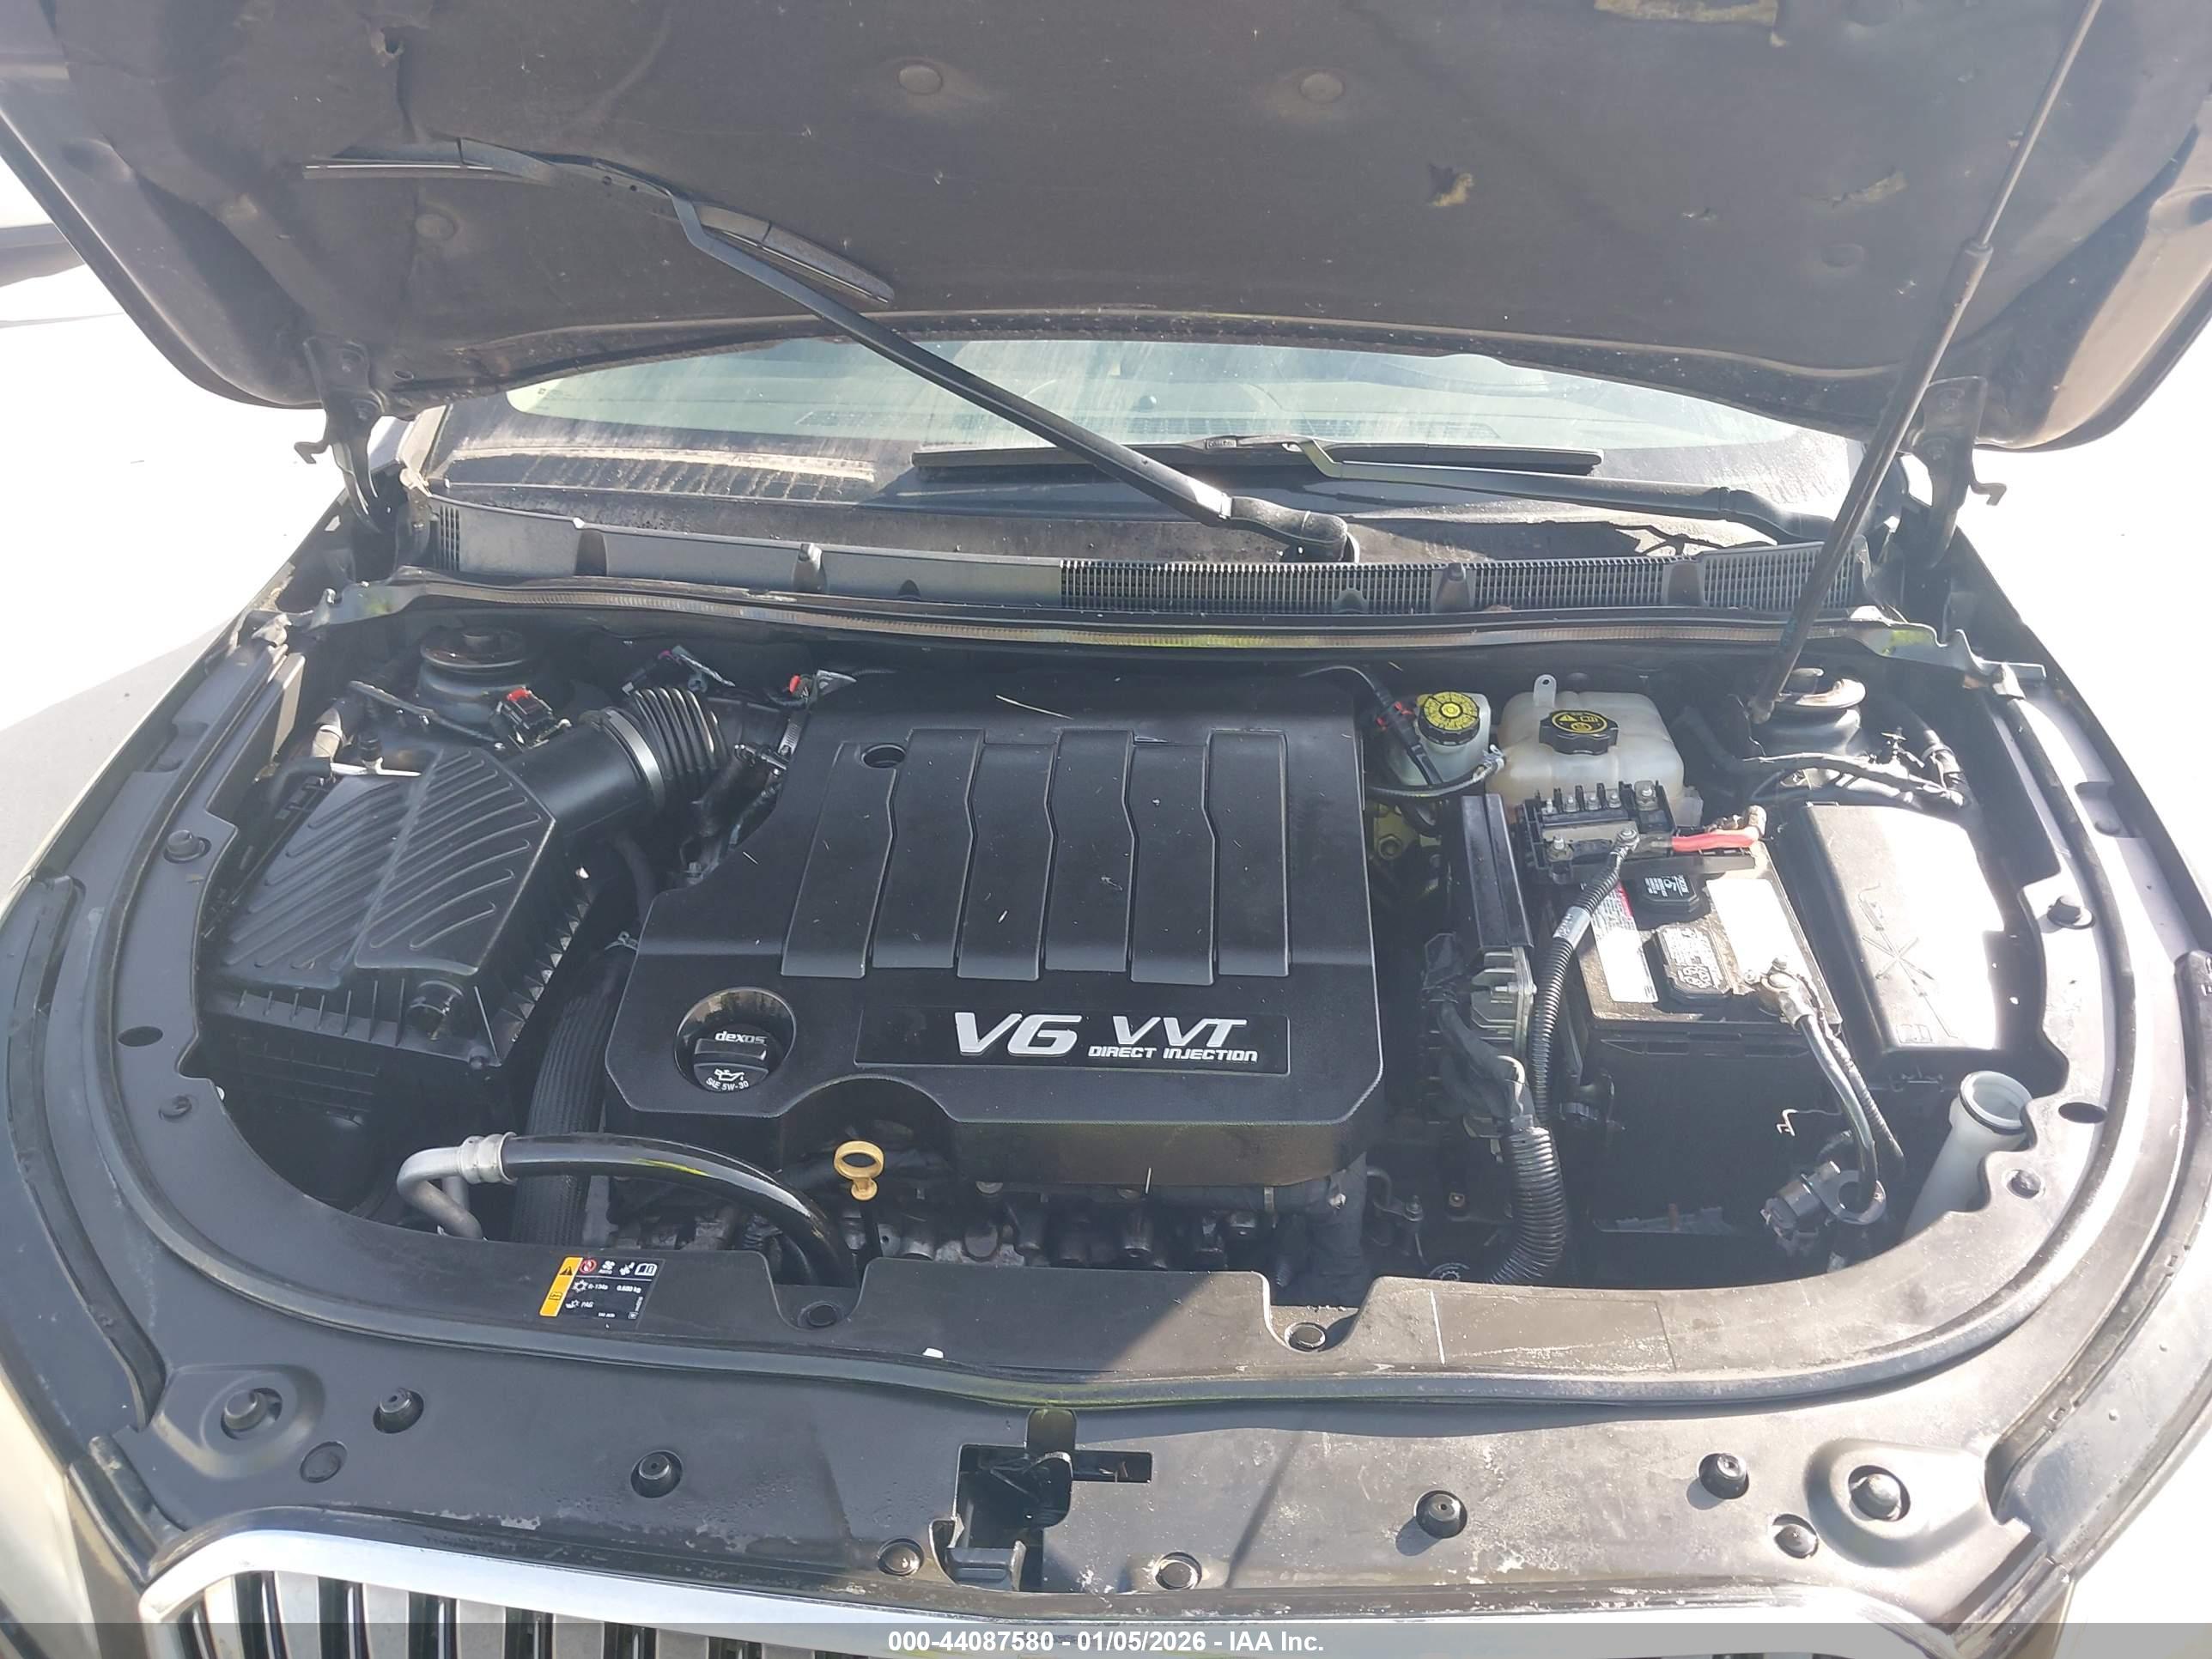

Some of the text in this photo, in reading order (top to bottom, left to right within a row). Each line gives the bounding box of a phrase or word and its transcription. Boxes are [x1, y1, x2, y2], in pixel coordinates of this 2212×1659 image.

[714, 1030, 769, 1045] dexos
[954, 1012, 1248, 1057] V6 VVT
[1087, 1045, 1258, 1062] DIRECT INJECTION
[705, 1077, 750, 1091] SAE 5W-30
